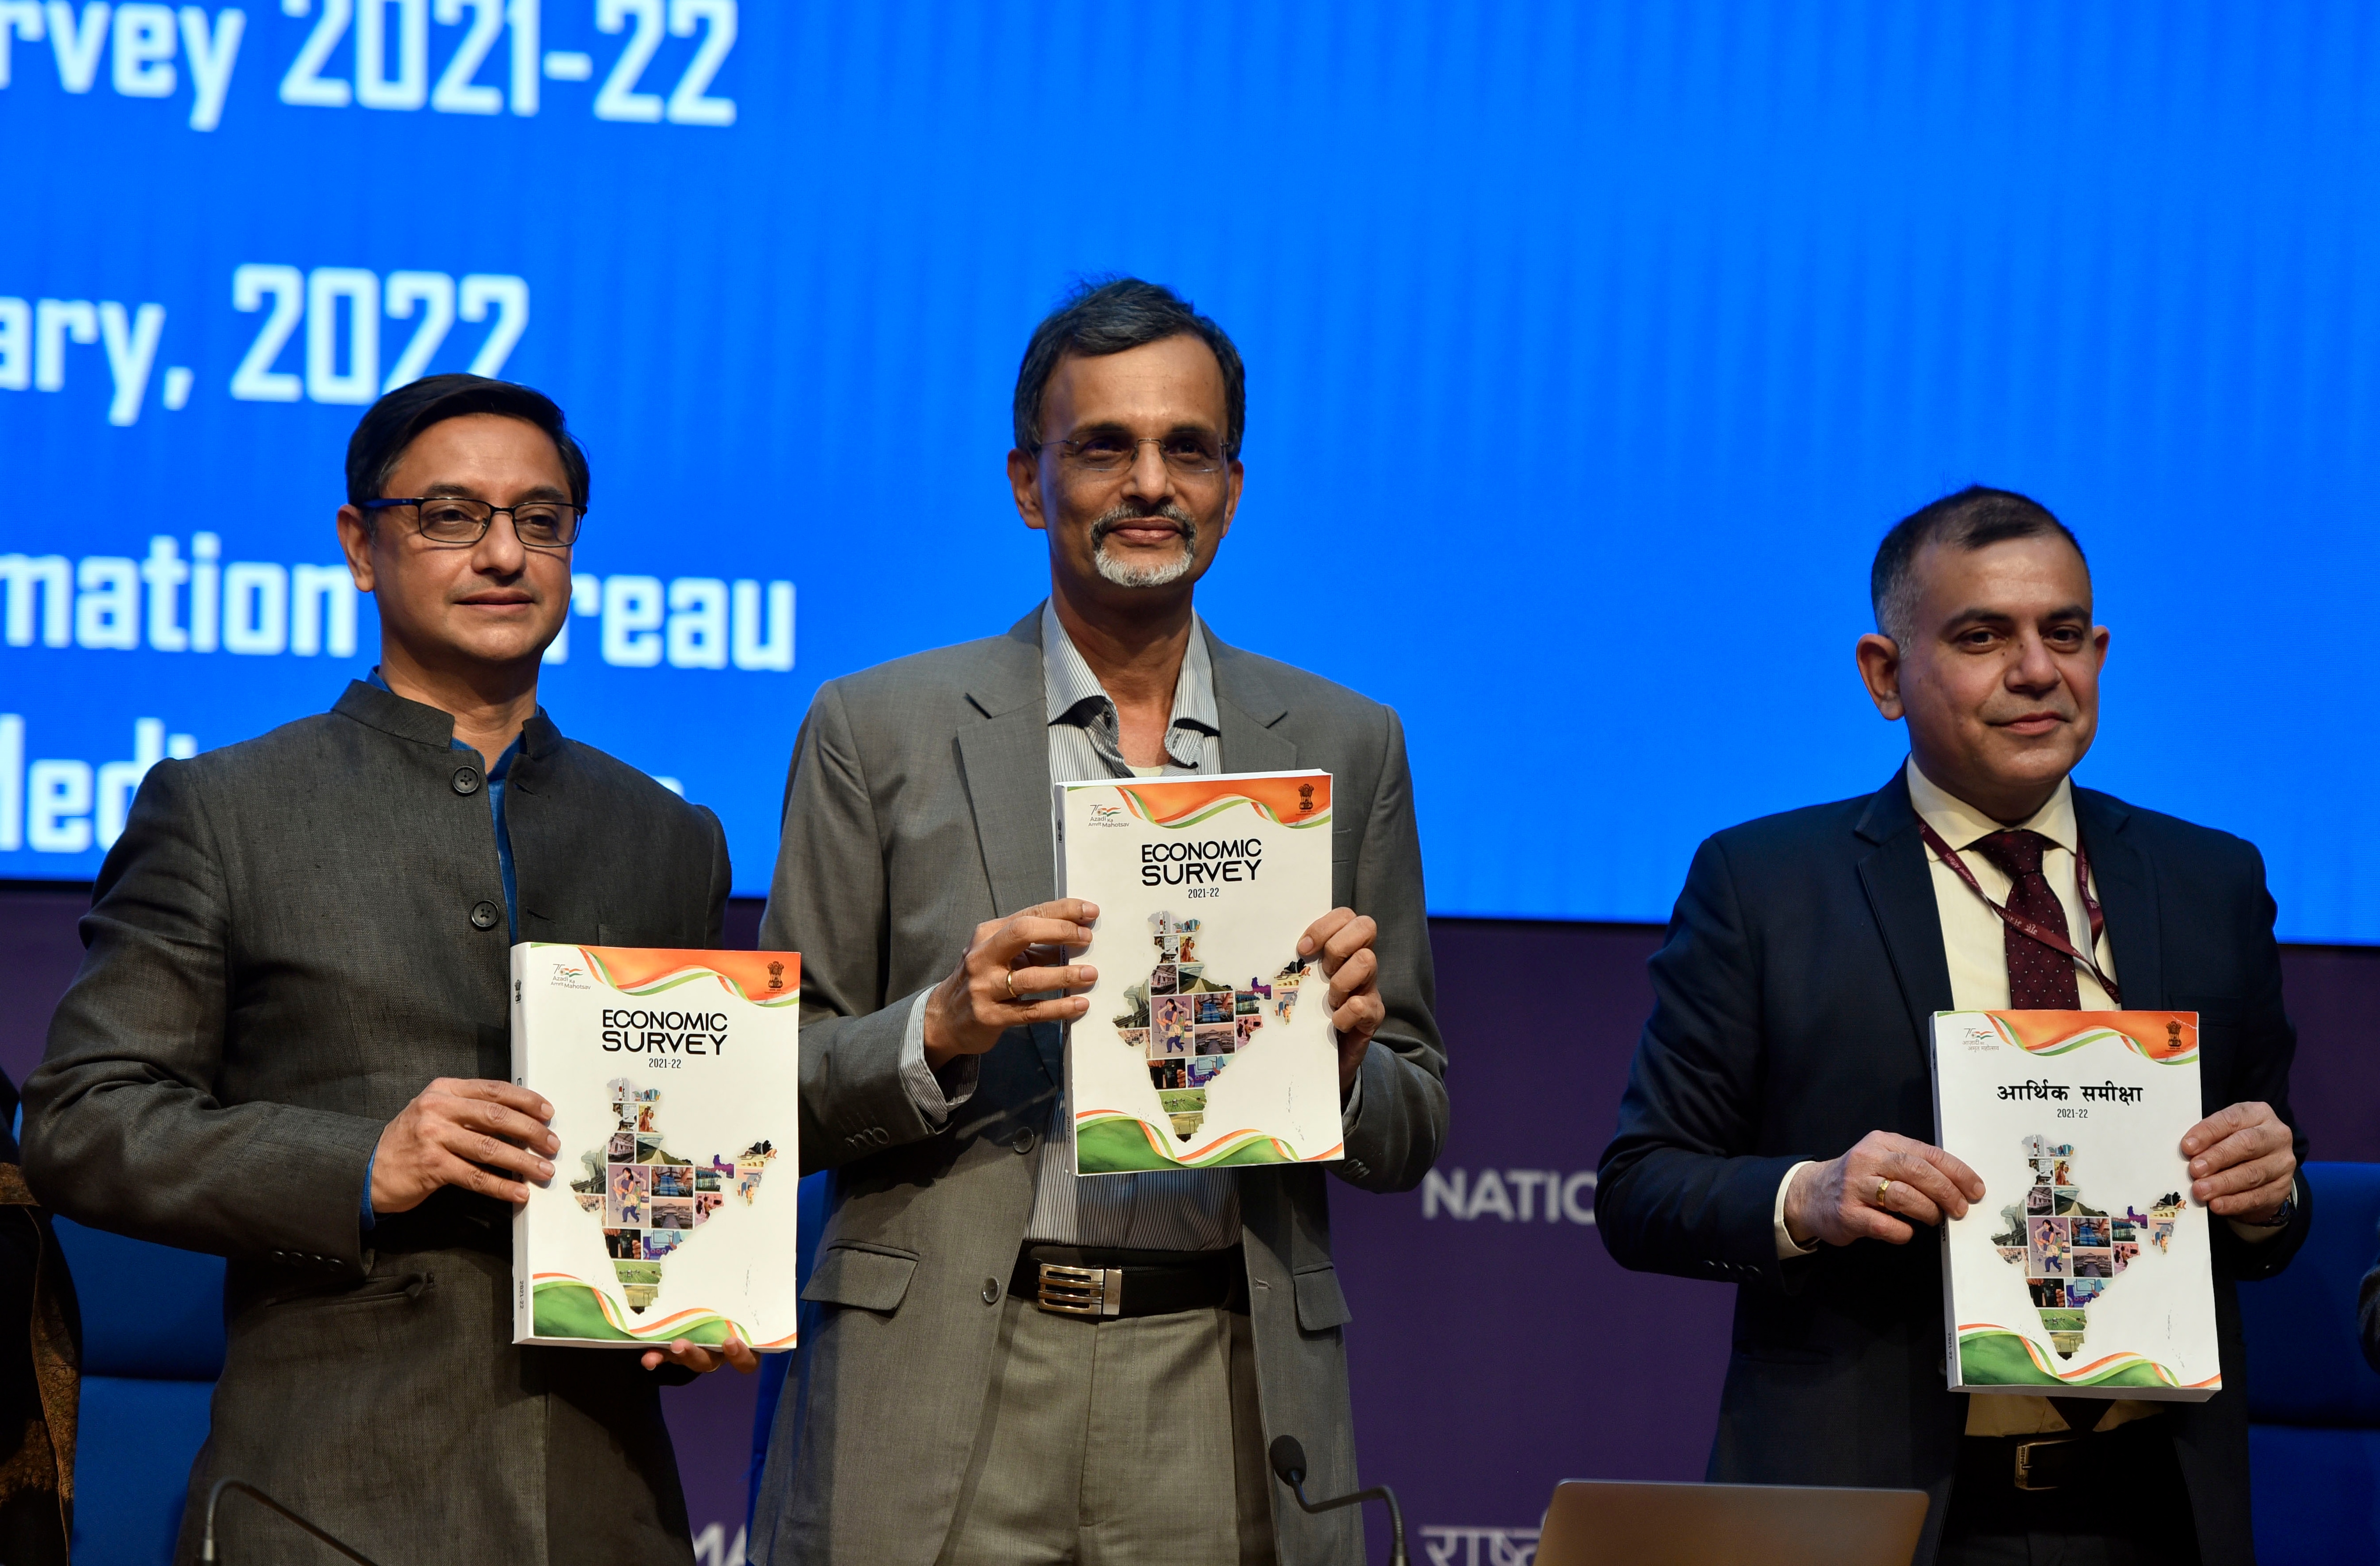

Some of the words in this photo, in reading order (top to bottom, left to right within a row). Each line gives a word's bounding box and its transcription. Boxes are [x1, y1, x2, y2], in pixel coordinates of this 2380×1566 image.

[280, 0, 738, 126] 2021-22
[230, 263, 529, 405] 2022
[1142, 838, 1262, 863] ECONOMIC
[1142, 859, 1262, 886] SURVEY
[1188, 888, 1220, 898] 2021-22
[603, 1009, 728, 1032] ECONOMIC
[602, 1031, 728, 1056] SURVEY
[649, 1058, 681, 1069] 2021-22
[1997, 1079, 2070, 1102] आर्थिक
[2080, 1080, 2144, 1106] समीक्षा
[2057, 1108, 2089, 1118] 2021-22
